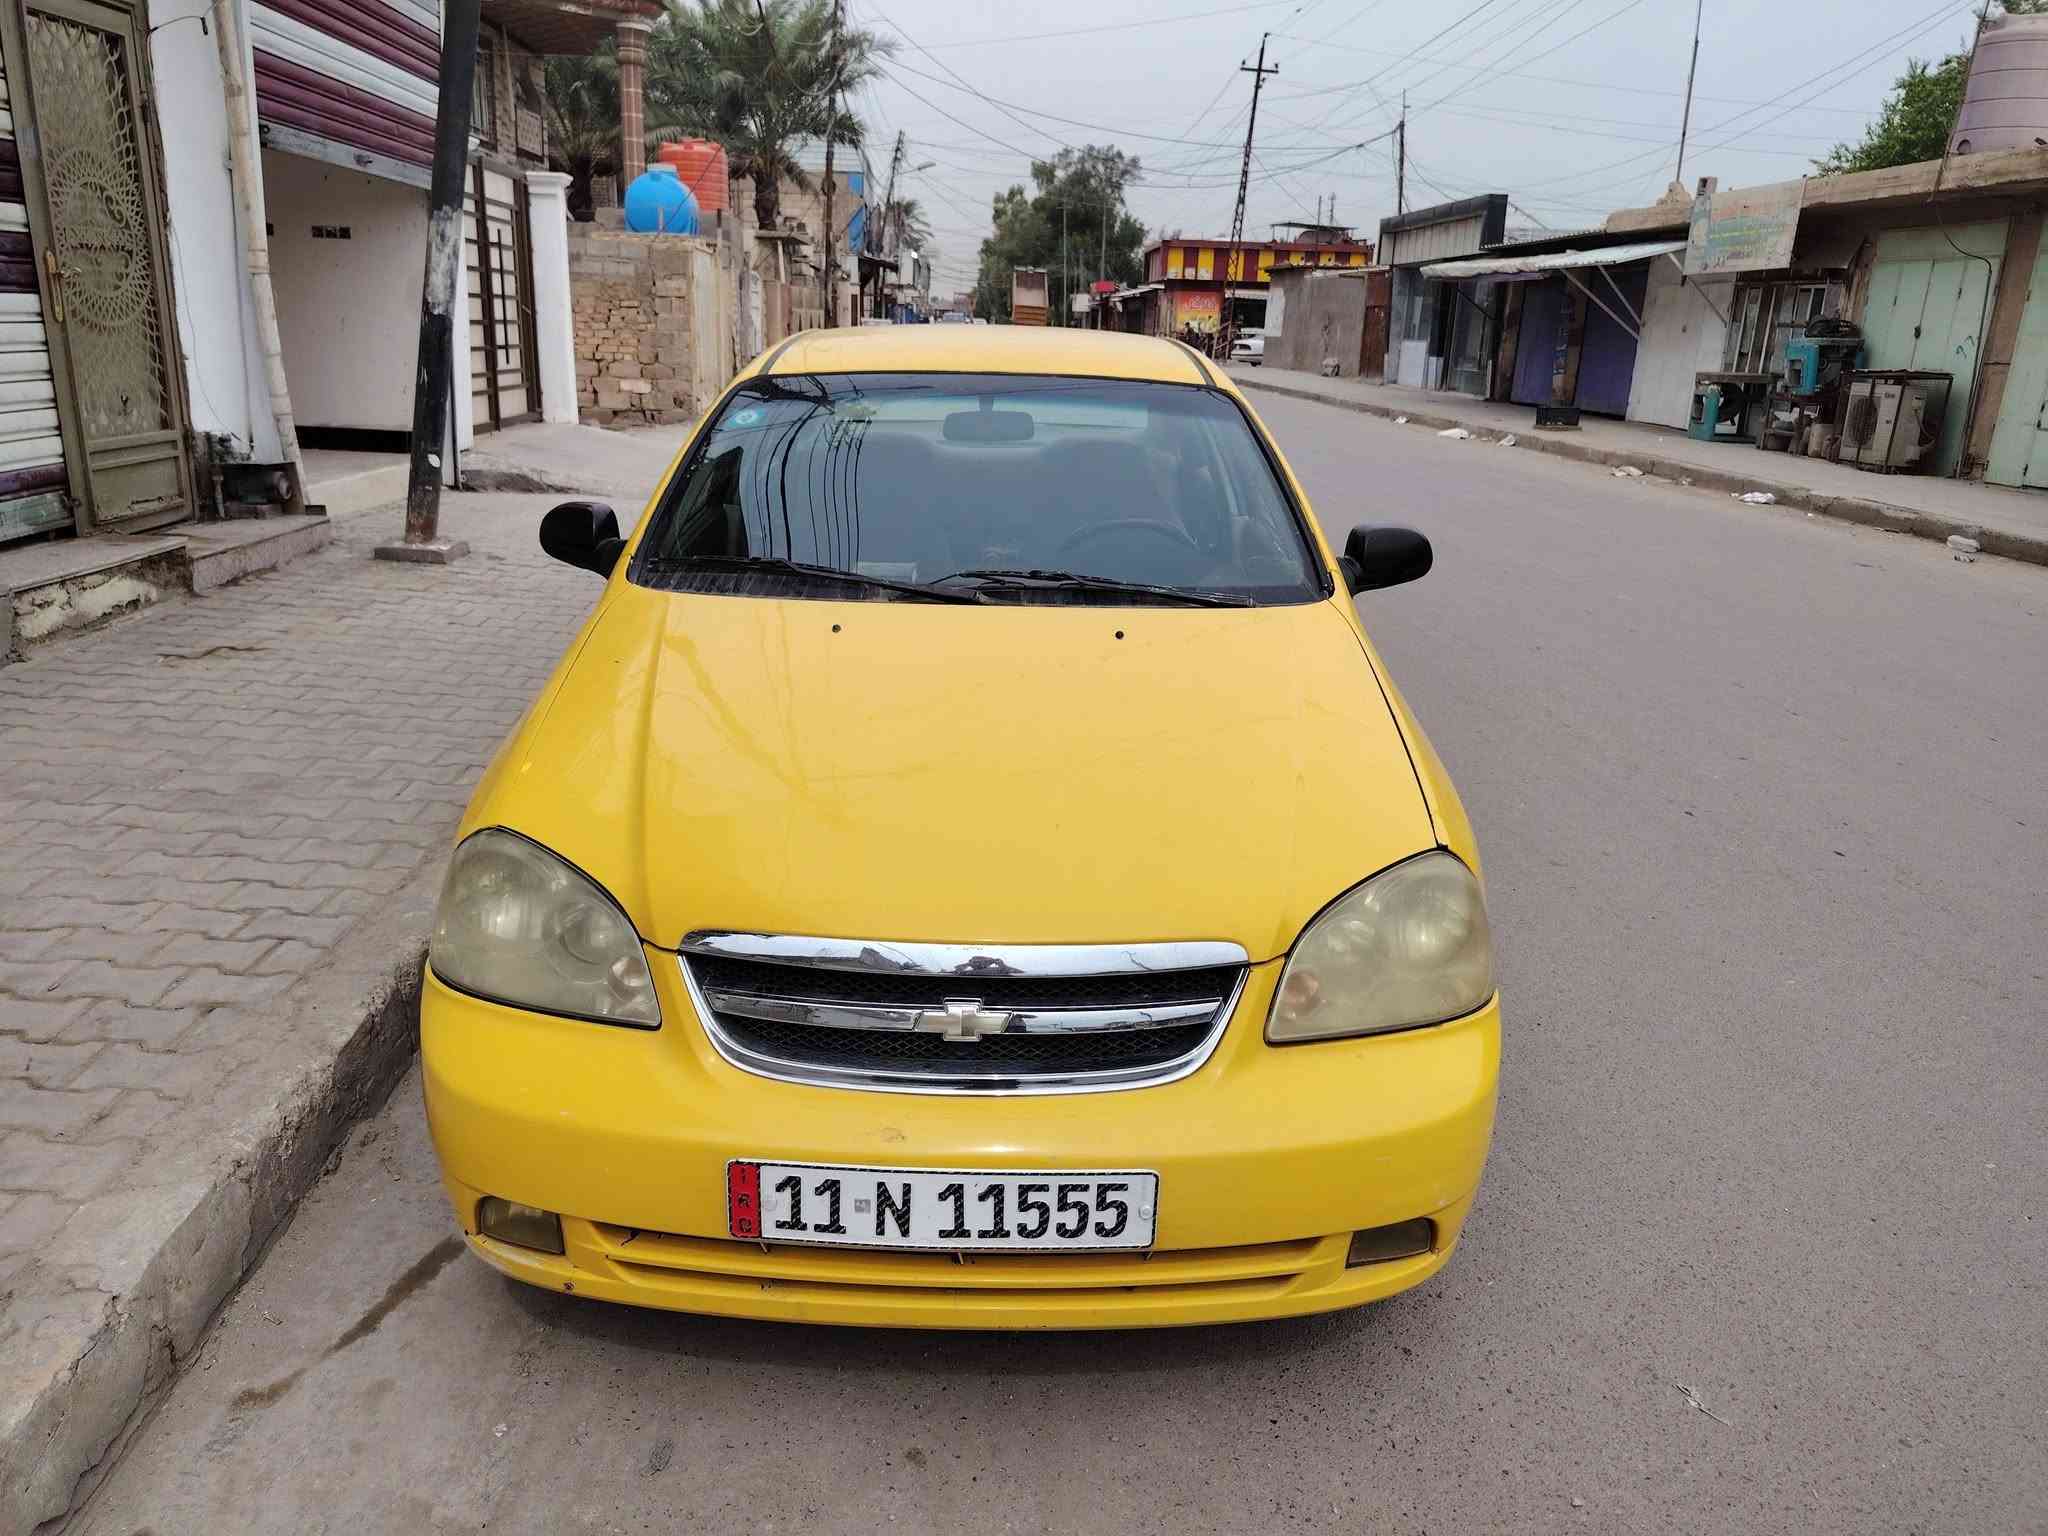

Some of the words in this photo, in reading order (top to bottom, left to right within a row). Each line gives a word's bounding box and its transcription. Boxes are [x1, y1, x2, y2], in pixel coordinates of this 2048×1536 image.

[775, 1175, 847, 1235] 11
[876, 1181, 912, 1238] N
[937, 1183, 1129, 1239] 11555
